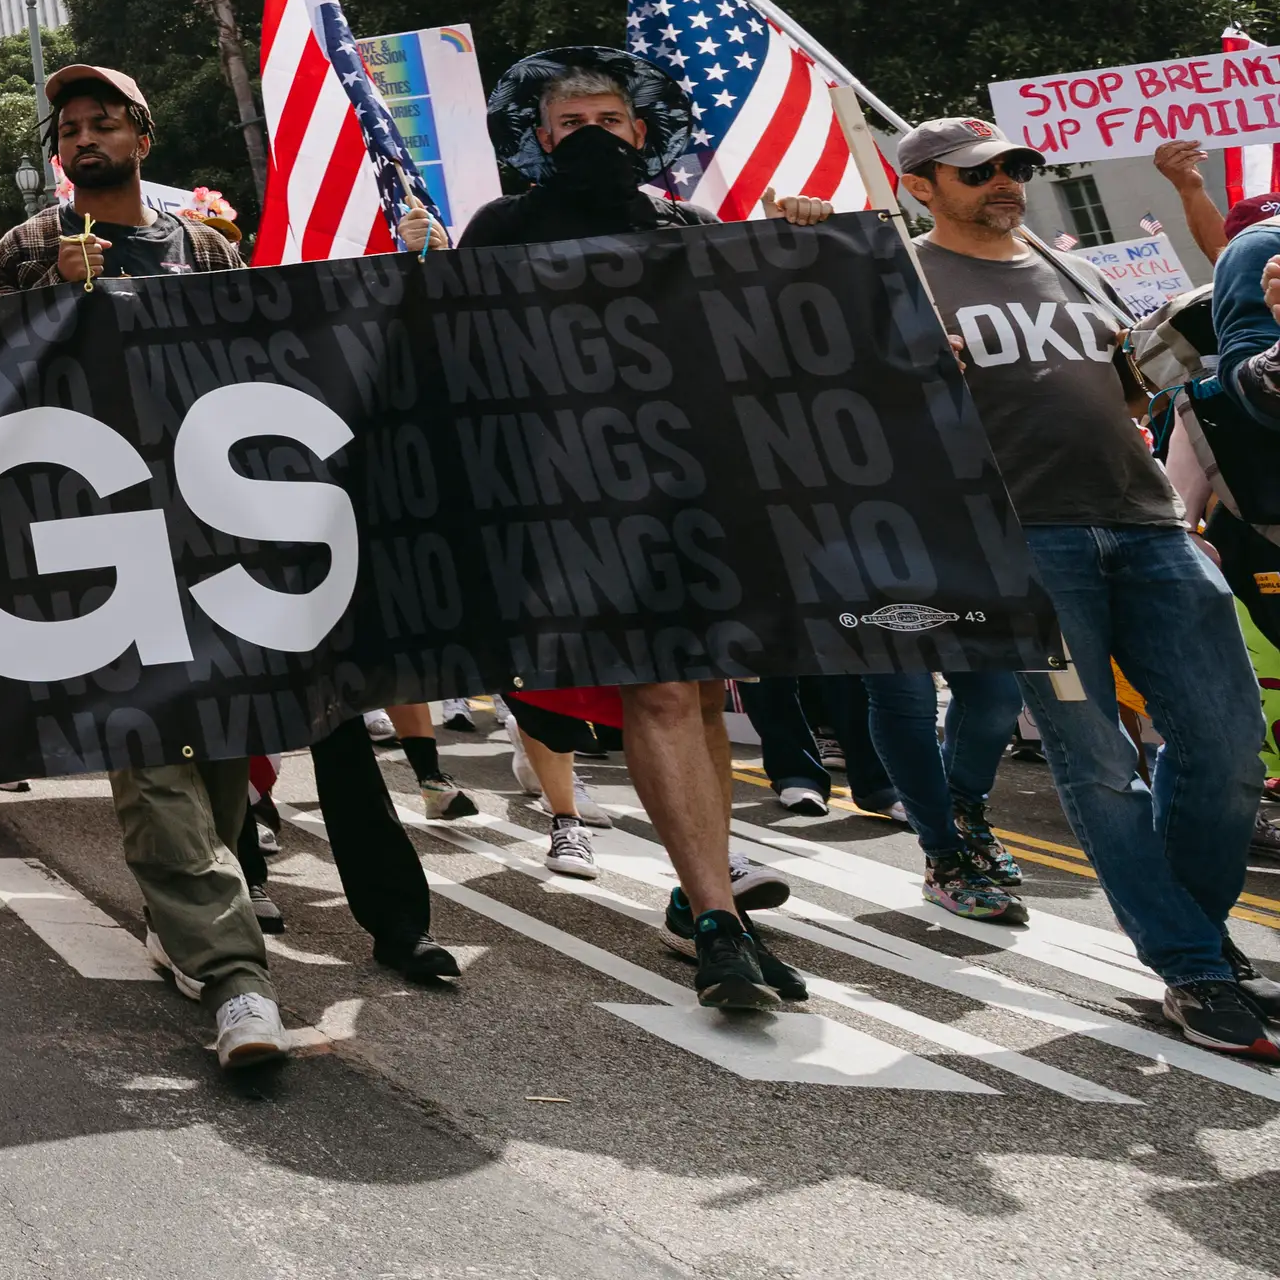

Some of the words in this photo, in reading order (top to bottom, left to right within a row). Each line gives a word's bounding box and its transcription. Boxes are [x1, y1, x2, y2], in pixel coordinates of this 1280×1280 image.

[381, 40, 390, 52] &
[363, 50, 407, 66] PASSION
[1019, 72, 1124, 117] STOP
[390, 104, 421, 119] URIES
[1023, 118, 1081, 152] UP
[1096, 93, 1280, 147] FAMILI
[963, 120, 992, 137] B
[1086, 251, 1119, 265] e're
[1126, 242, 1160, 261] NOT
[1101, 259, 1180, 280] ADICAL
[1124, 295, 1155, 313] the
[955, 302, 1120, 367] OKC
[333, 317, 417, 416] NO
[433, 296, 674, 403] KINGS
[699, 282, 855, 383] NO
[365, 424, 441, 524] NO
[456, 401, 706, 510] KINGS
[733, 388, 894, 491] NO
[369, 532, 463, 638] NO
[480, 507, 742, 620] KINGS
[766, 500, 940, 605] NO
[965, 611, 986, 623] 43
